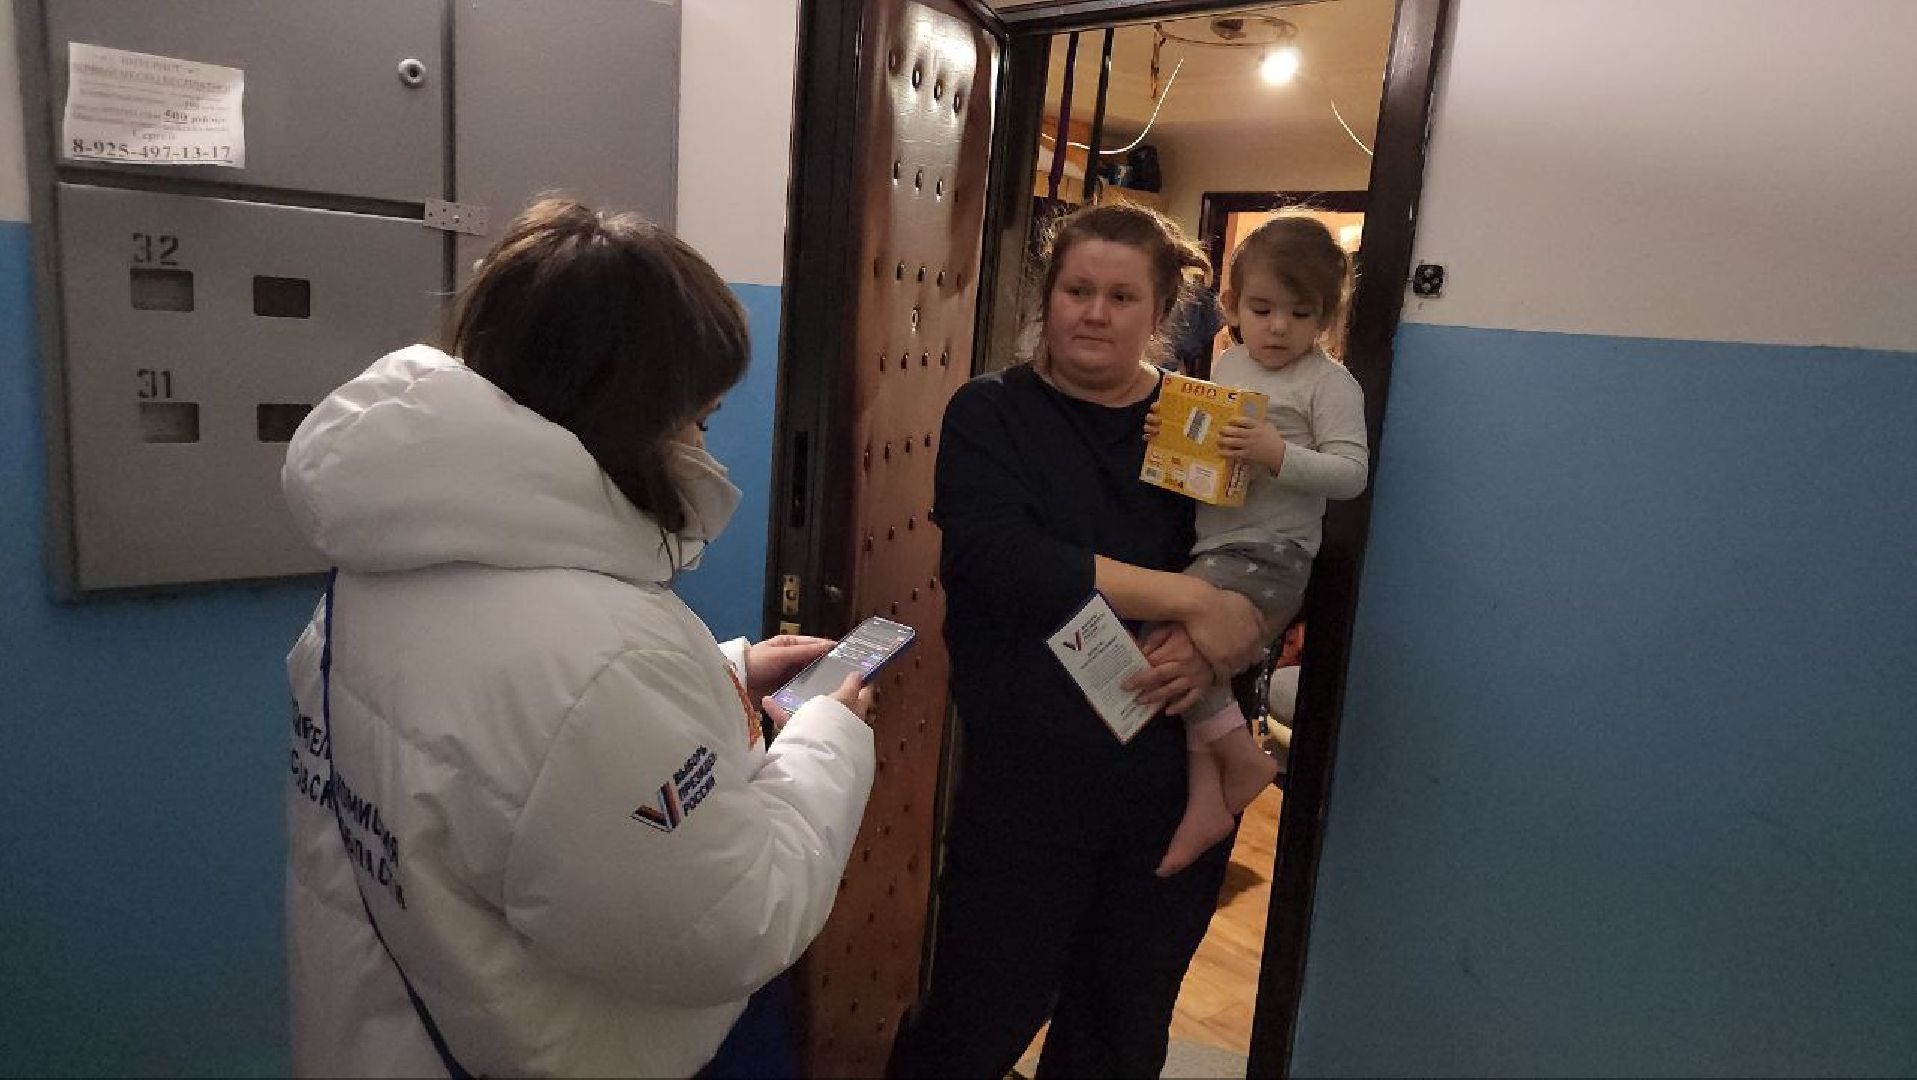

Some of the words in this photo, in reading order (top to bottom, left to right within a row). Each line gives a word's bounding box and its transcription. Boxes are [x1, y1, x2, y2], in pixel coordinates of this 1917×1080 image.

[72, 138, 232, 160] 8-925-497-13-17
[132, 232, 179, 266] 32
[136, 368, 173, 399] 31
